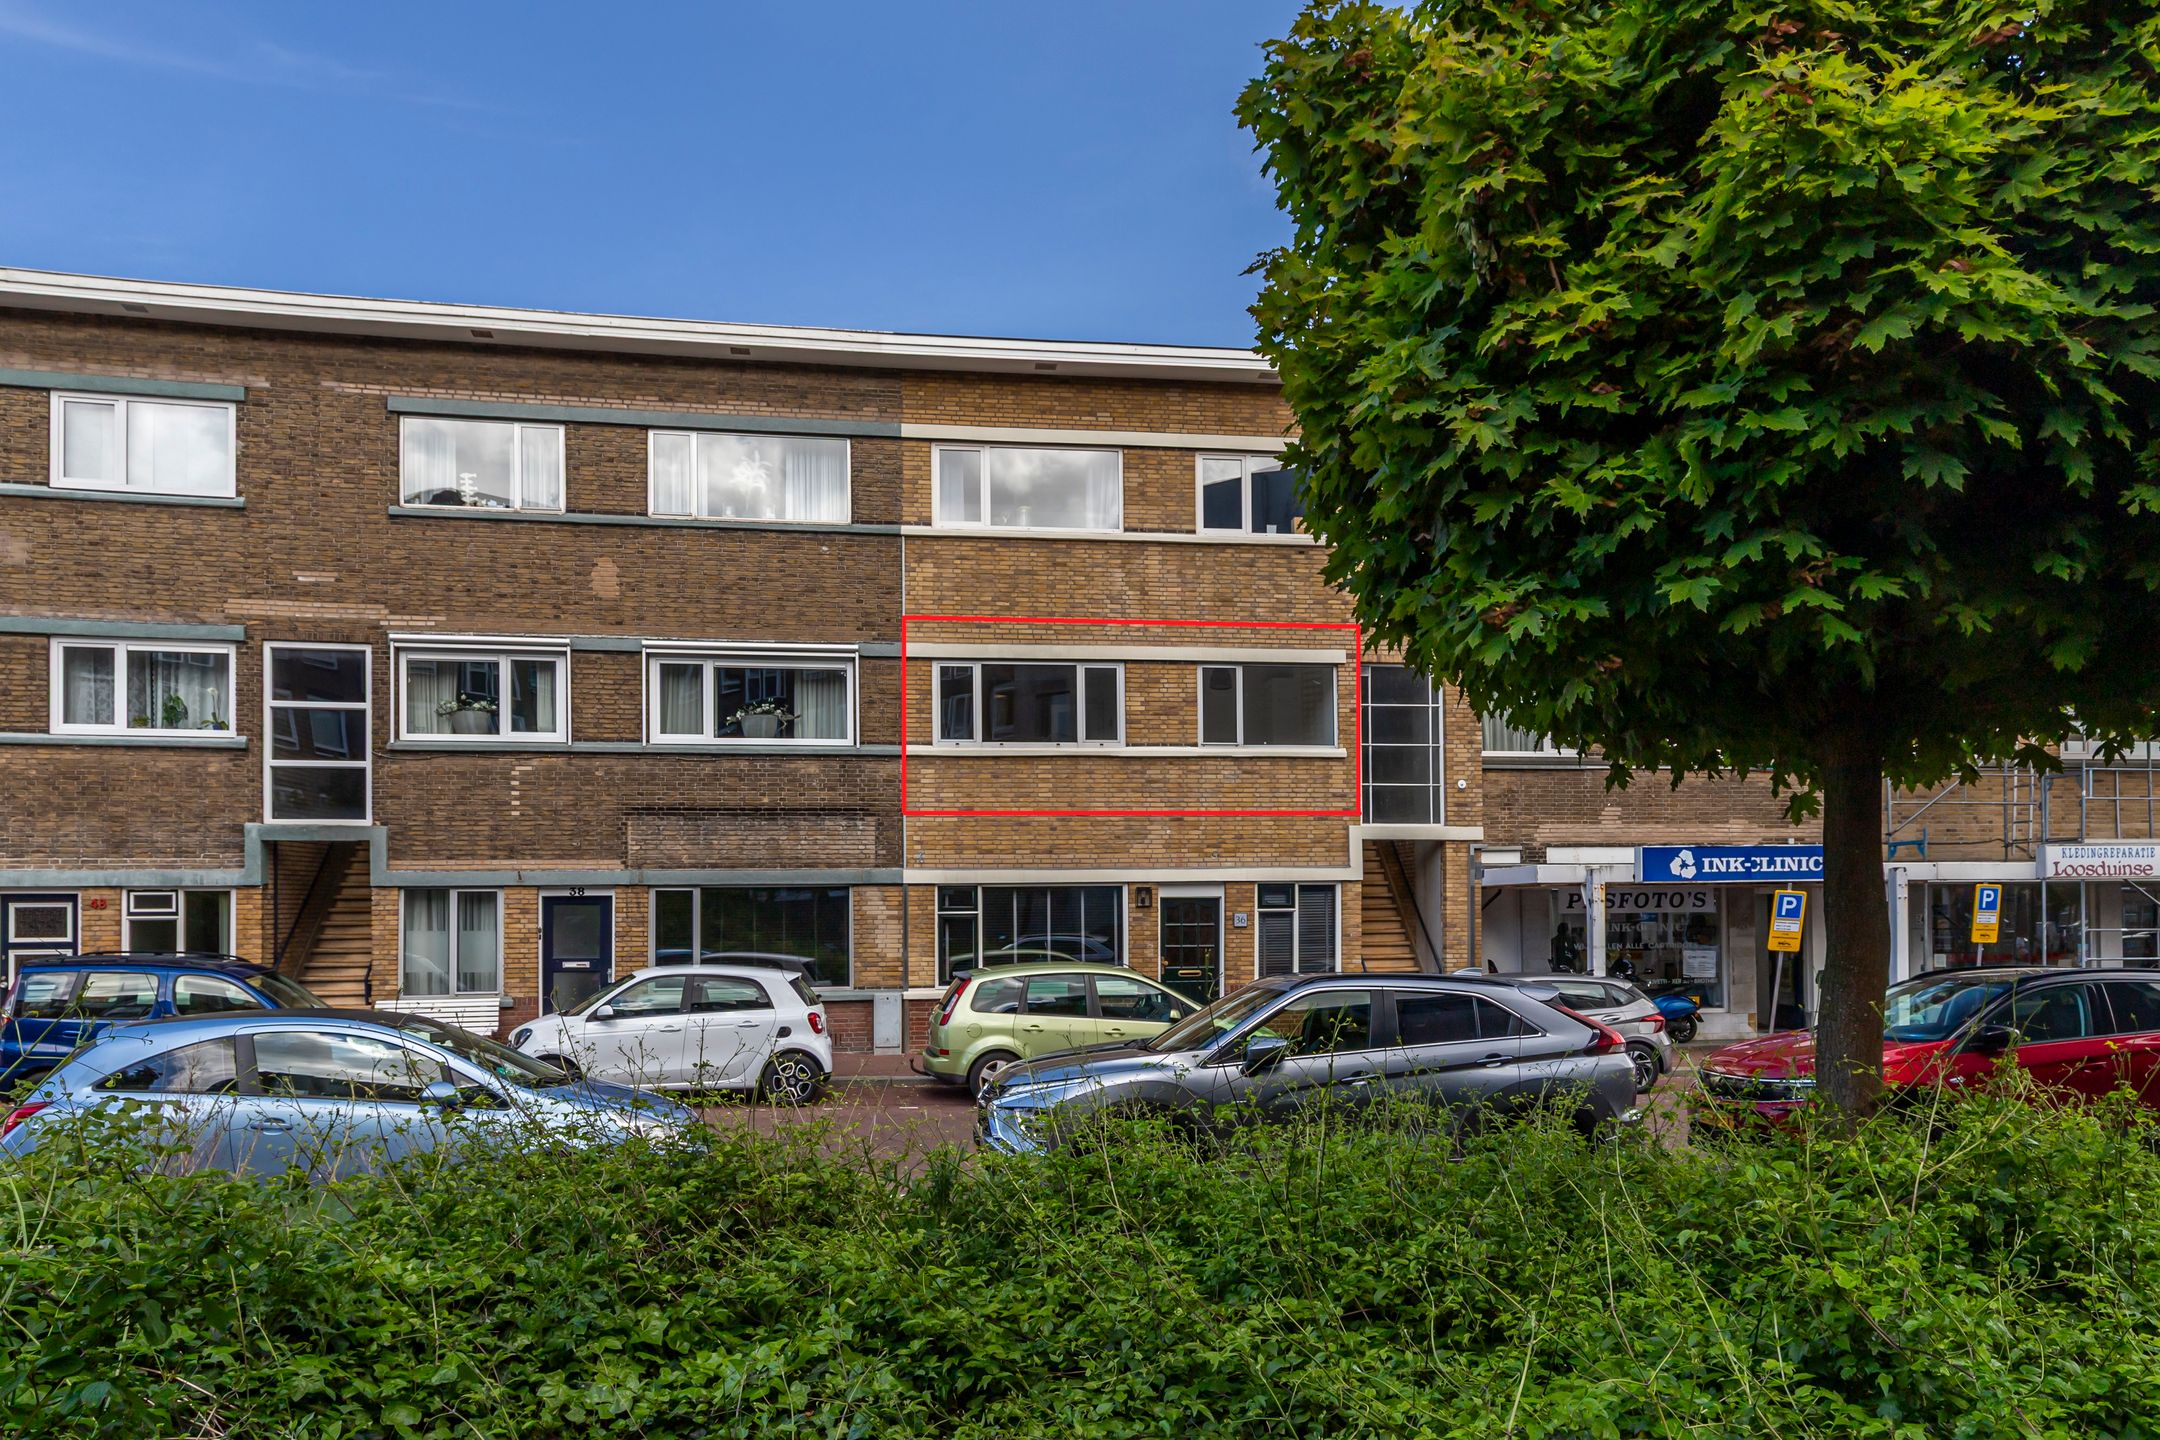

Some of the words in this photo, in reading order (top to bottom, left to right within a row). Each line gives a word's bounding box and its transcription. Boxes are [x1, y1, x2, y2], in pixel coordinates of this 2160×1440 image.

[2061, 847, 2156, 859] KLEDINGREPARATIE
[1702, 856, 1824, 873] INK-CLINIC
[2053, 860, 2154, 876] Loosduinse
[569, 886, 585, 896] 38
[1566, 891, 1708, 909] PSFOTO'S
[1781, 896, 1798, 916] P
[1981, 890, 1995, 909] P
[1235, 915, 1246, 926] 36
[1625, 942, 1644, 950] ALLE
